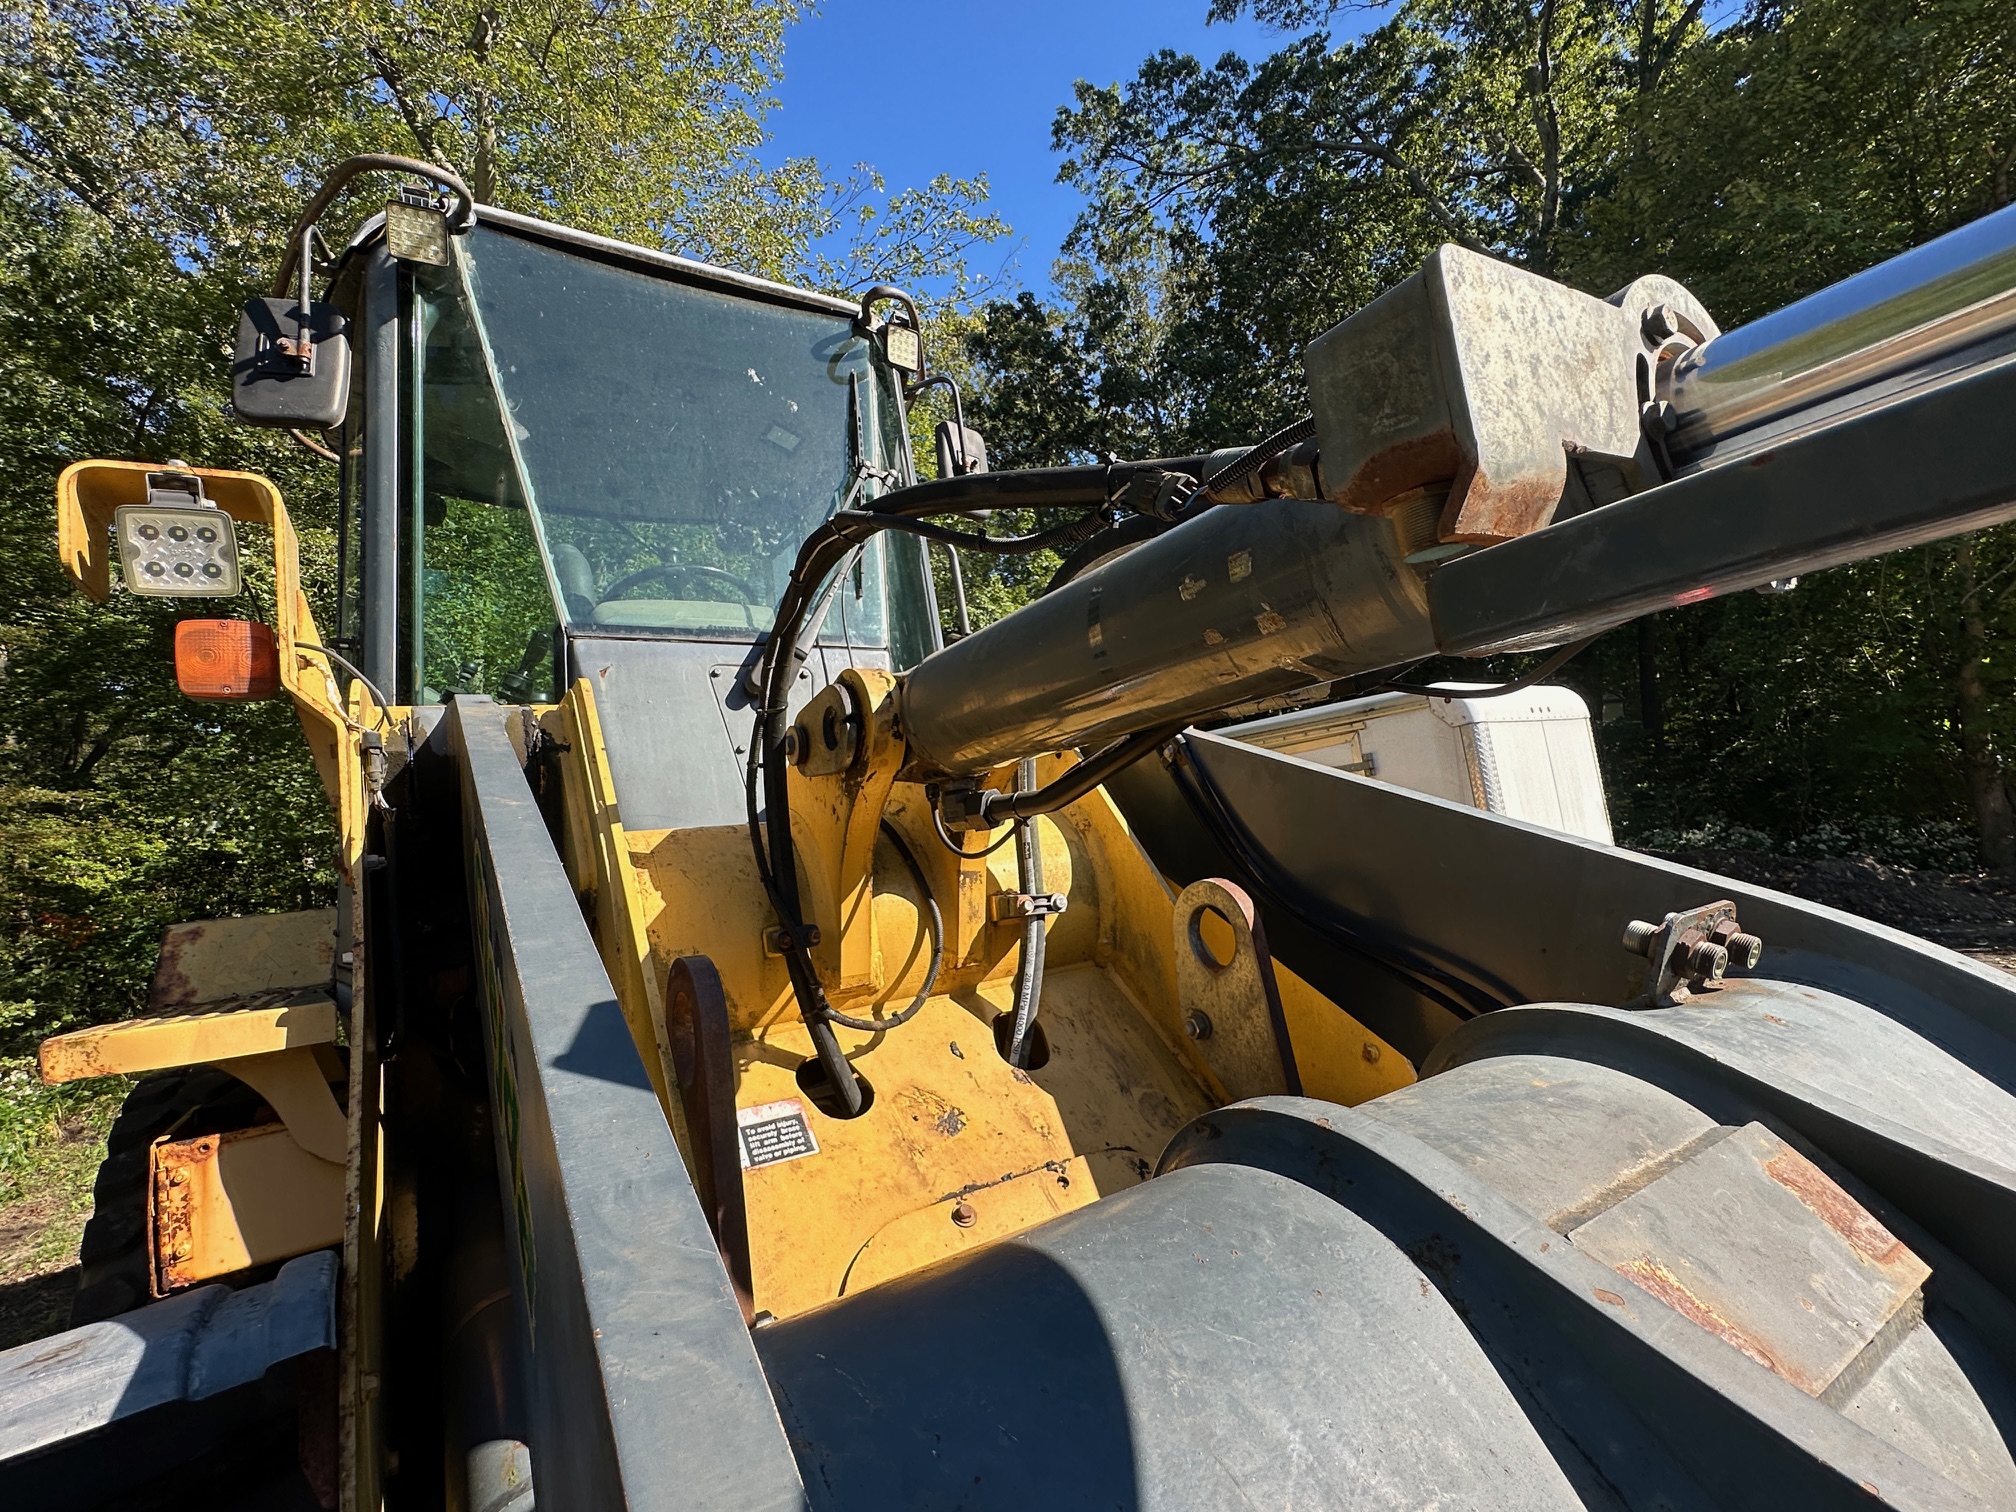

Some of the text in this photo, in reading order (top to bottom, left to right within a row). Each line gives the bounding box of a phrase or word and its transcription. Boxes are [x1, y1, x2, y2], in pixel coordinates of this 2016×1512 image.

[1024, 973, 1032, 990] 28.0
[1020, 992, 1029, 1012] MPa
[1016, 1012, 1025, 1036] (4000
[1012, 1038, 1021, 1055] PSI)
[748, 1125, 800, 1142] securely brace
[756, 1122, 776, 1133] avoid
[749, 1131, 803, 1149] lift arm before
[752, 1136, 805, 1155] disassembly of
[753, 1153, 773, 1162] valve
[782, 1145, 807, 1156] piping.
